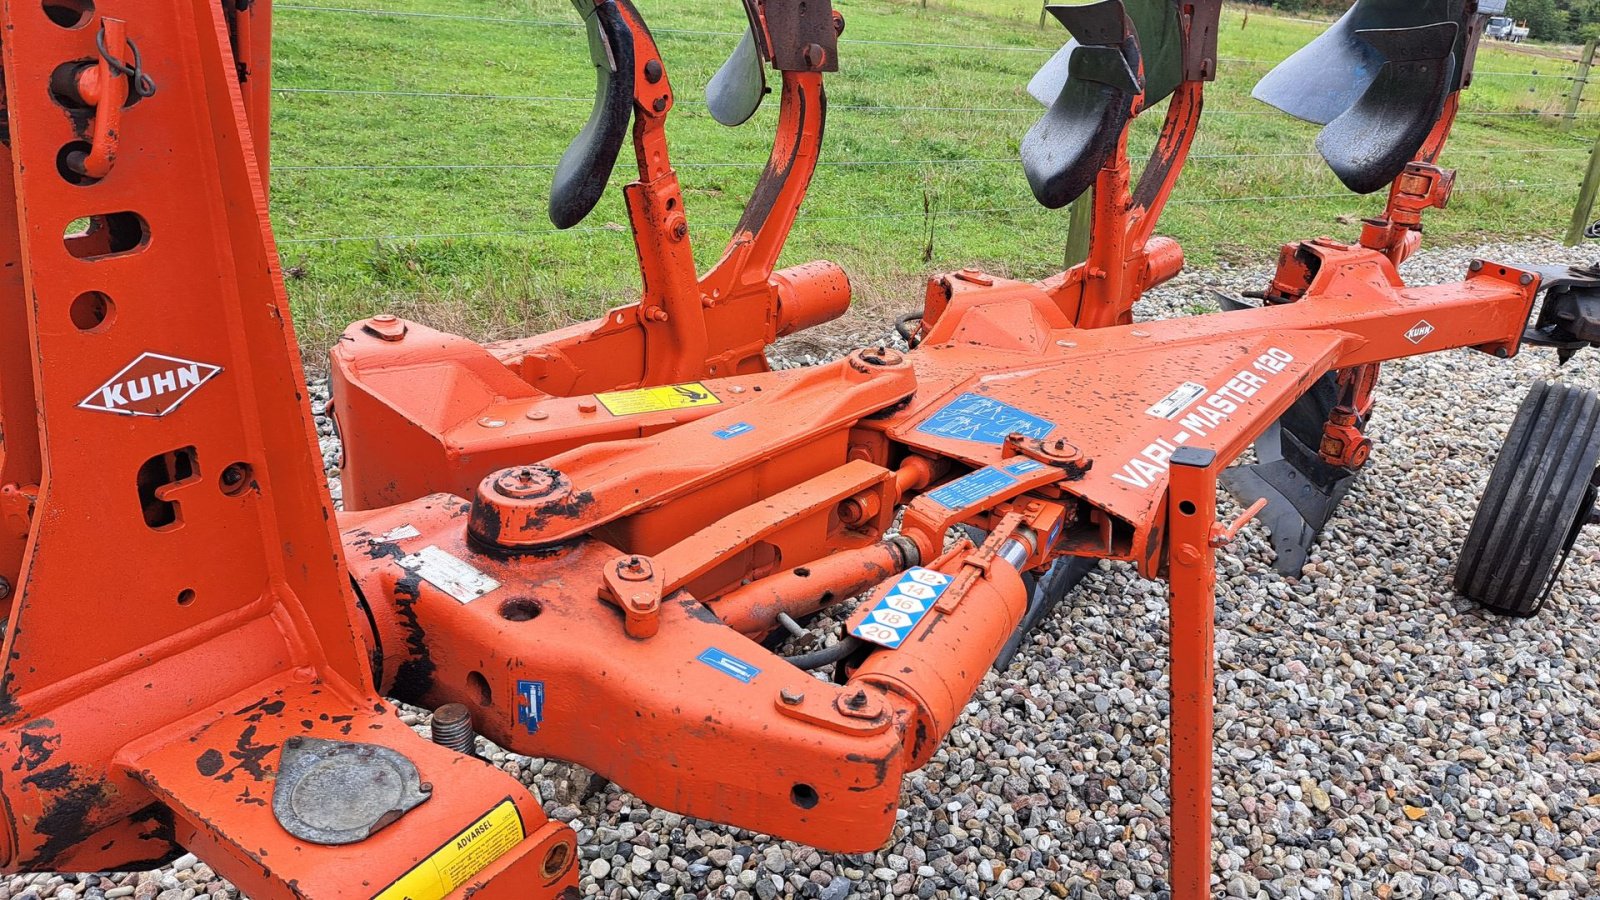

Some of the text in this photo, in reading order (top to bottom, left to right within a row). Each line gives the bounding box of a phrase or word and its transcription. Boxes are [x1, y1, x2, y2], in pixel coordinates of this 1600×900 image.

[1408, 326, 1431, 338] KUHN
[1253, 347, 1294, 375] 120
[102, 363, 201, 409] KUHN
[919, 572, 937, 582] 12
[907, 584, 924, 596] 14
[894, 598, 914, 610] 16
[882, 612, 902, 625] 18
[865, 626, 891, 640] 20
[457, 820, 493, 851] ADVARSEL
